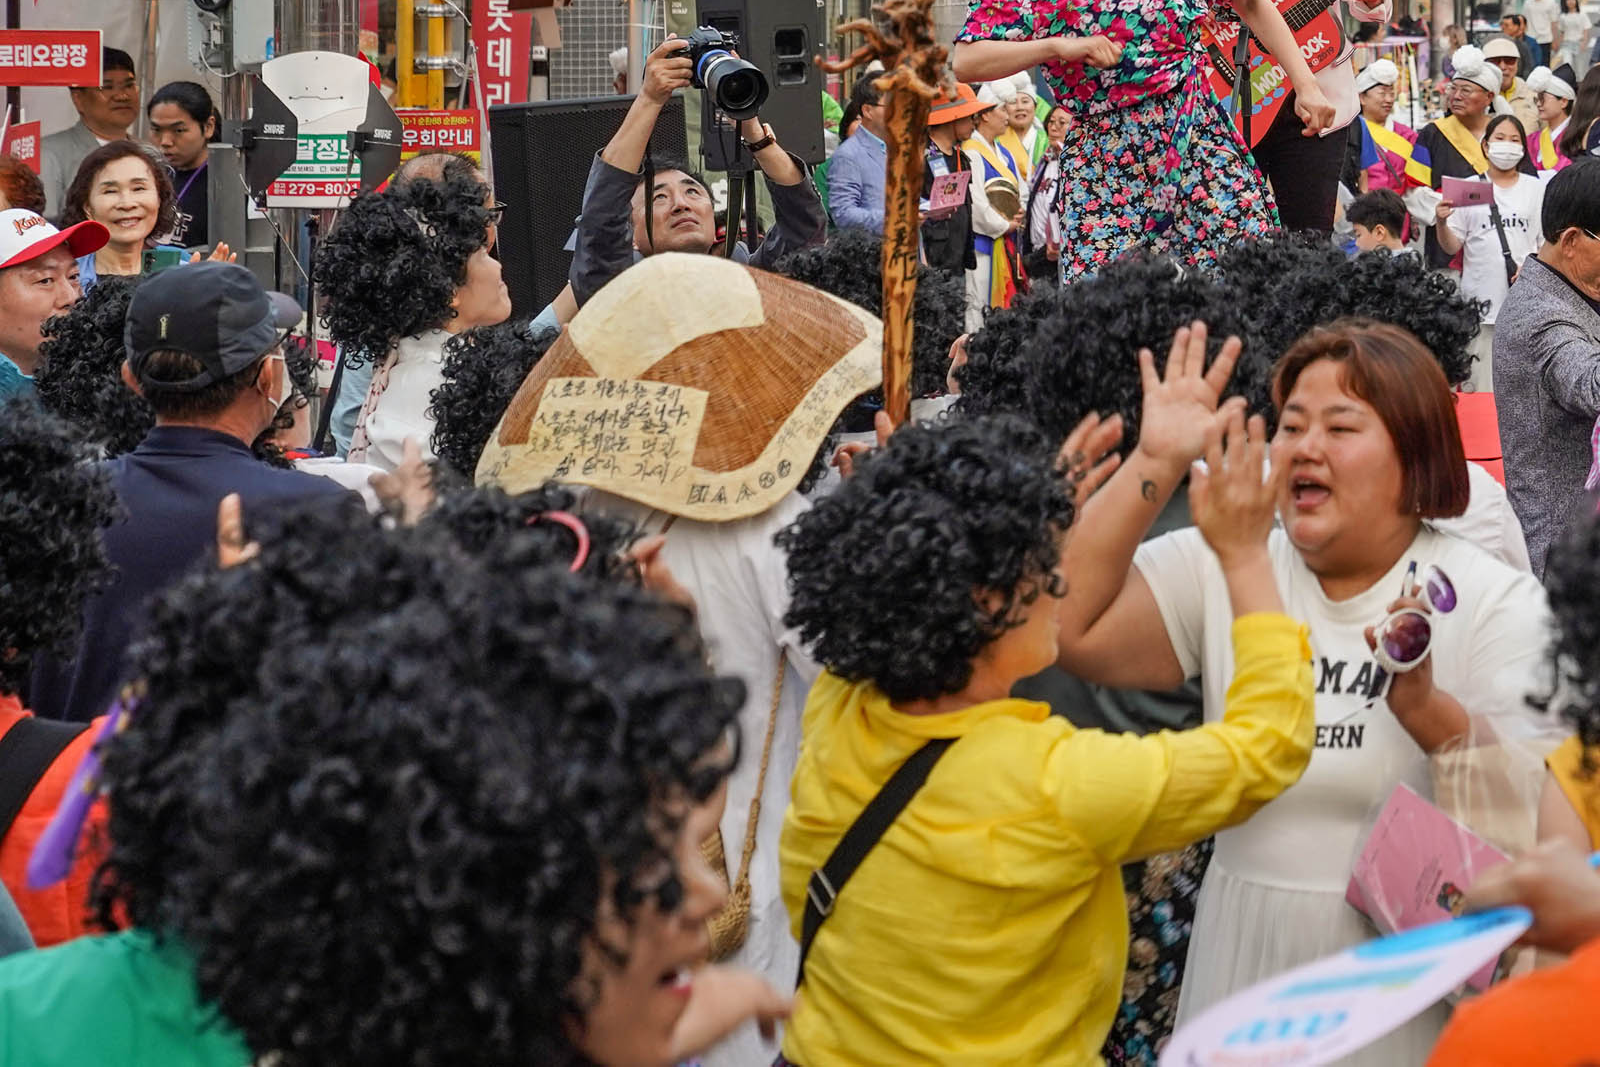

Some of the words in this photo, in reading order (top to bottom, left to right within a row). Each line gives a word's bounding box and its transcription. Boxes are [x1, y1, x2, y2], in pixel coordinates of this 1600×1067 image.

[263, 124, 286, 135] SHURE
[373, 128, 393, 140] SHURE
[402, 128, 473, 147] 우회안내
